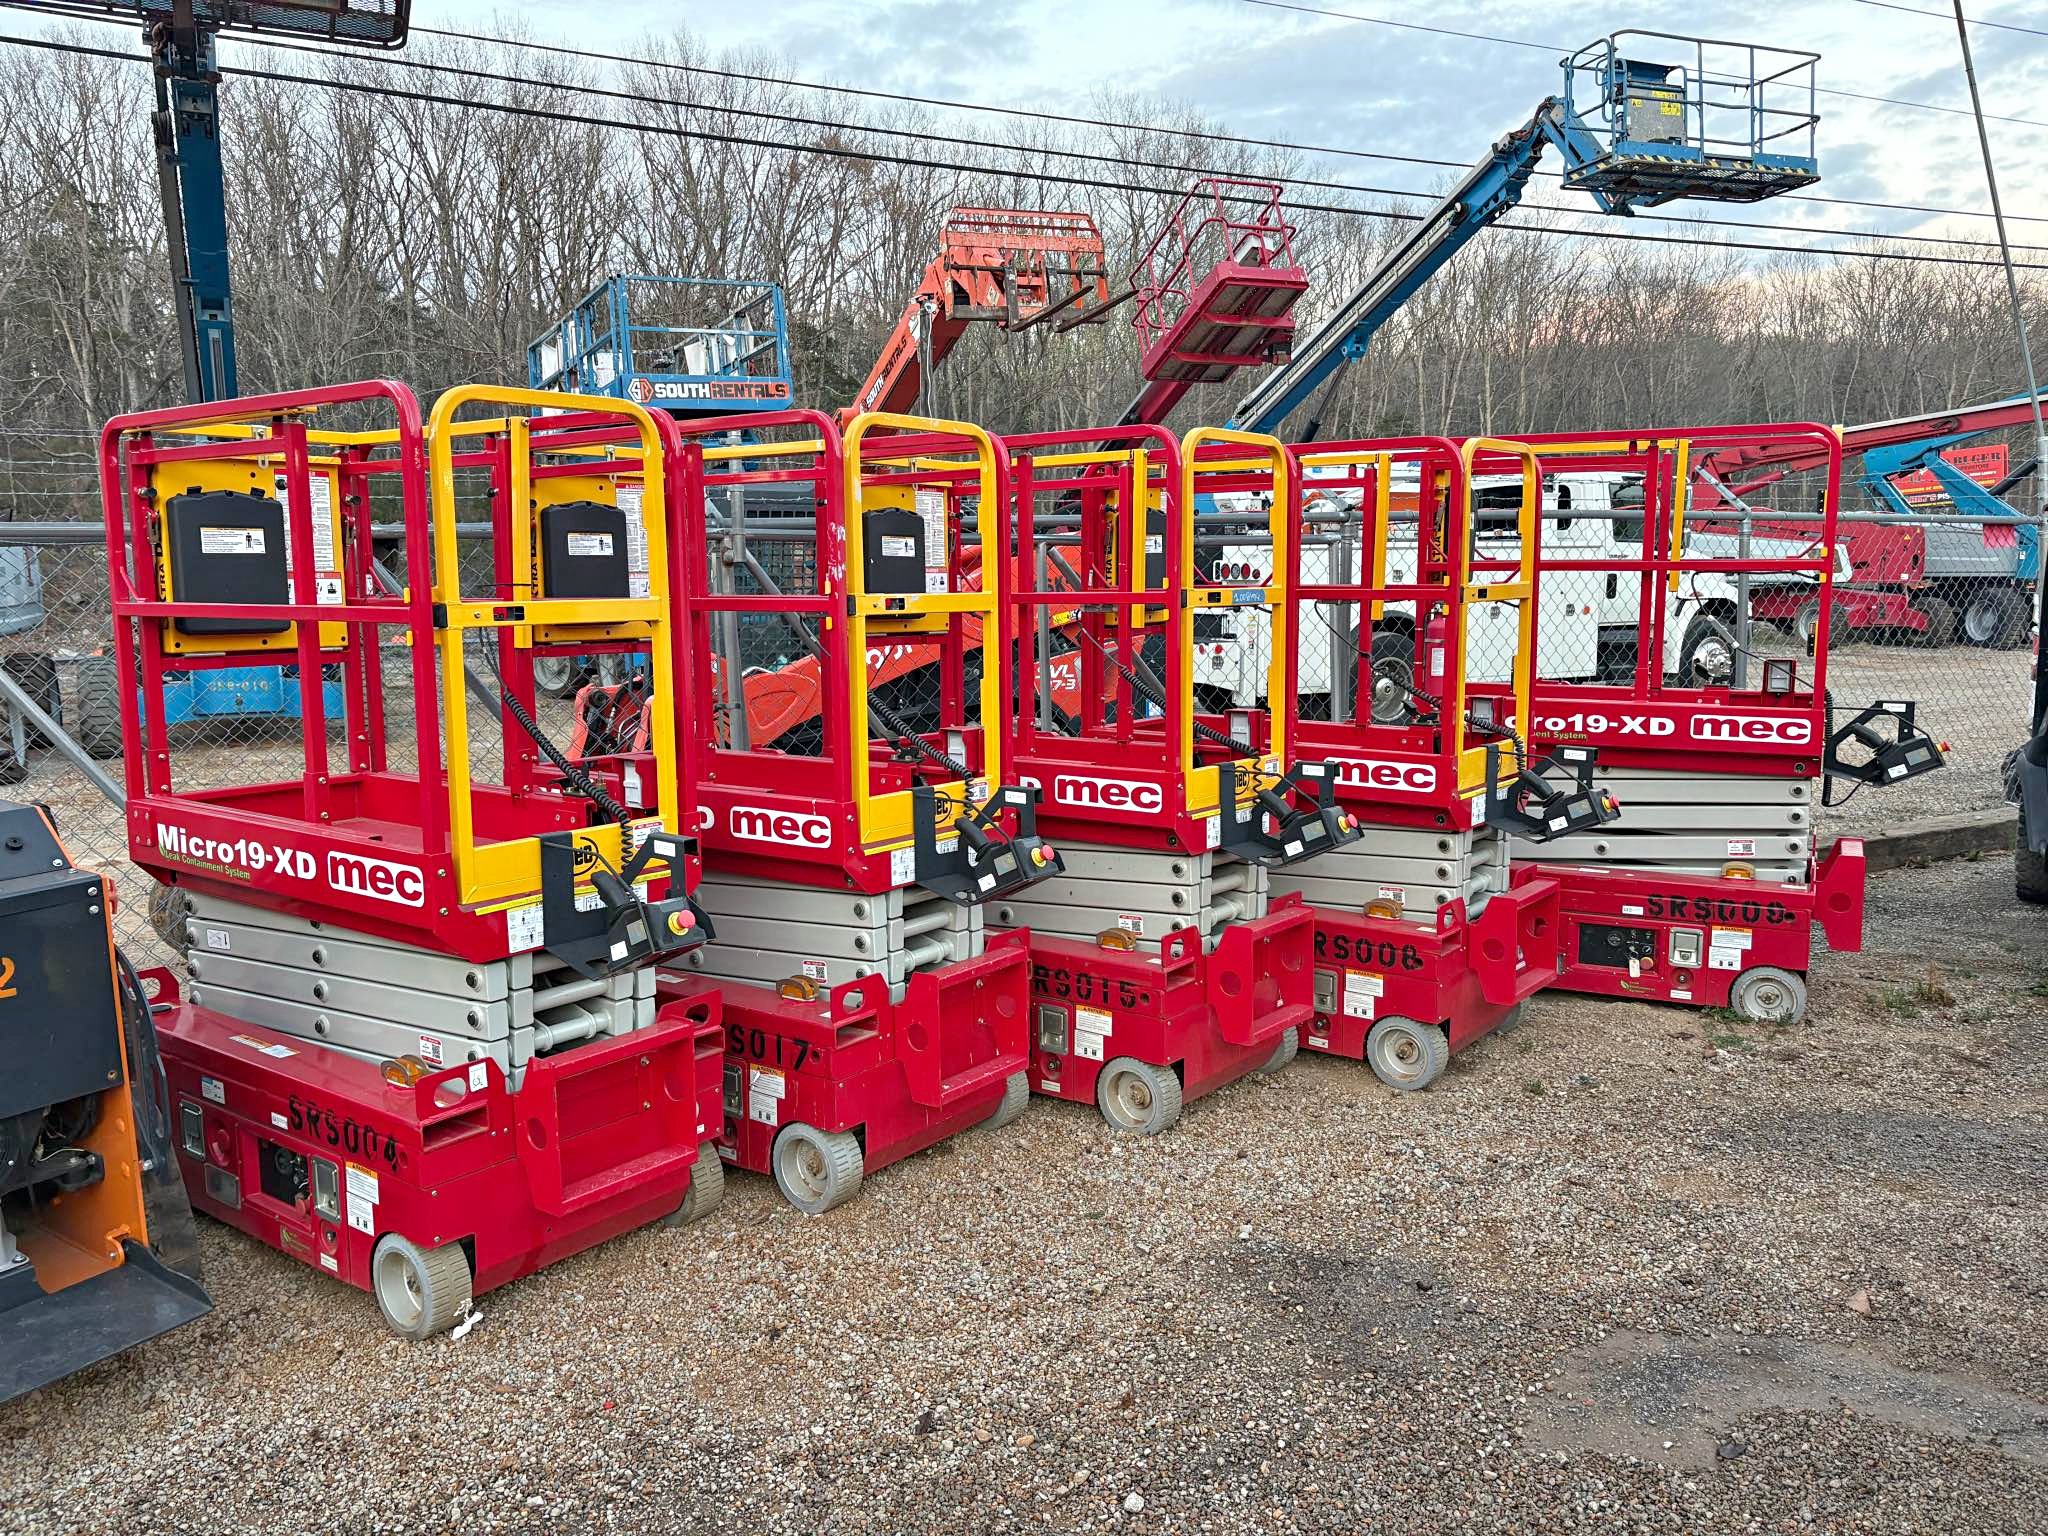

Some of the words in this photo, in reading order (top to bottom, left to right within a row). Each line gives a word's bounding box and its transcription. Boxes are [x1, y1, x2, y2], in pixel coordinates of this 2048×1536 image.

[1553, 731, 1588, 742] System
[1692, 717, 1810, 741] mec
[1336, 760, 1435, 789] mec
[1057, 778, 1161, 809] mec
[732, 809, 830, 844] mec
[157, 823, 317, 880] Micro19-XD
[330, 855, 423, 901] mec
[164, 849, 181, 863] Leak
[182, 855, 223, 873] Containment
[224, 863, 250, 880] System
